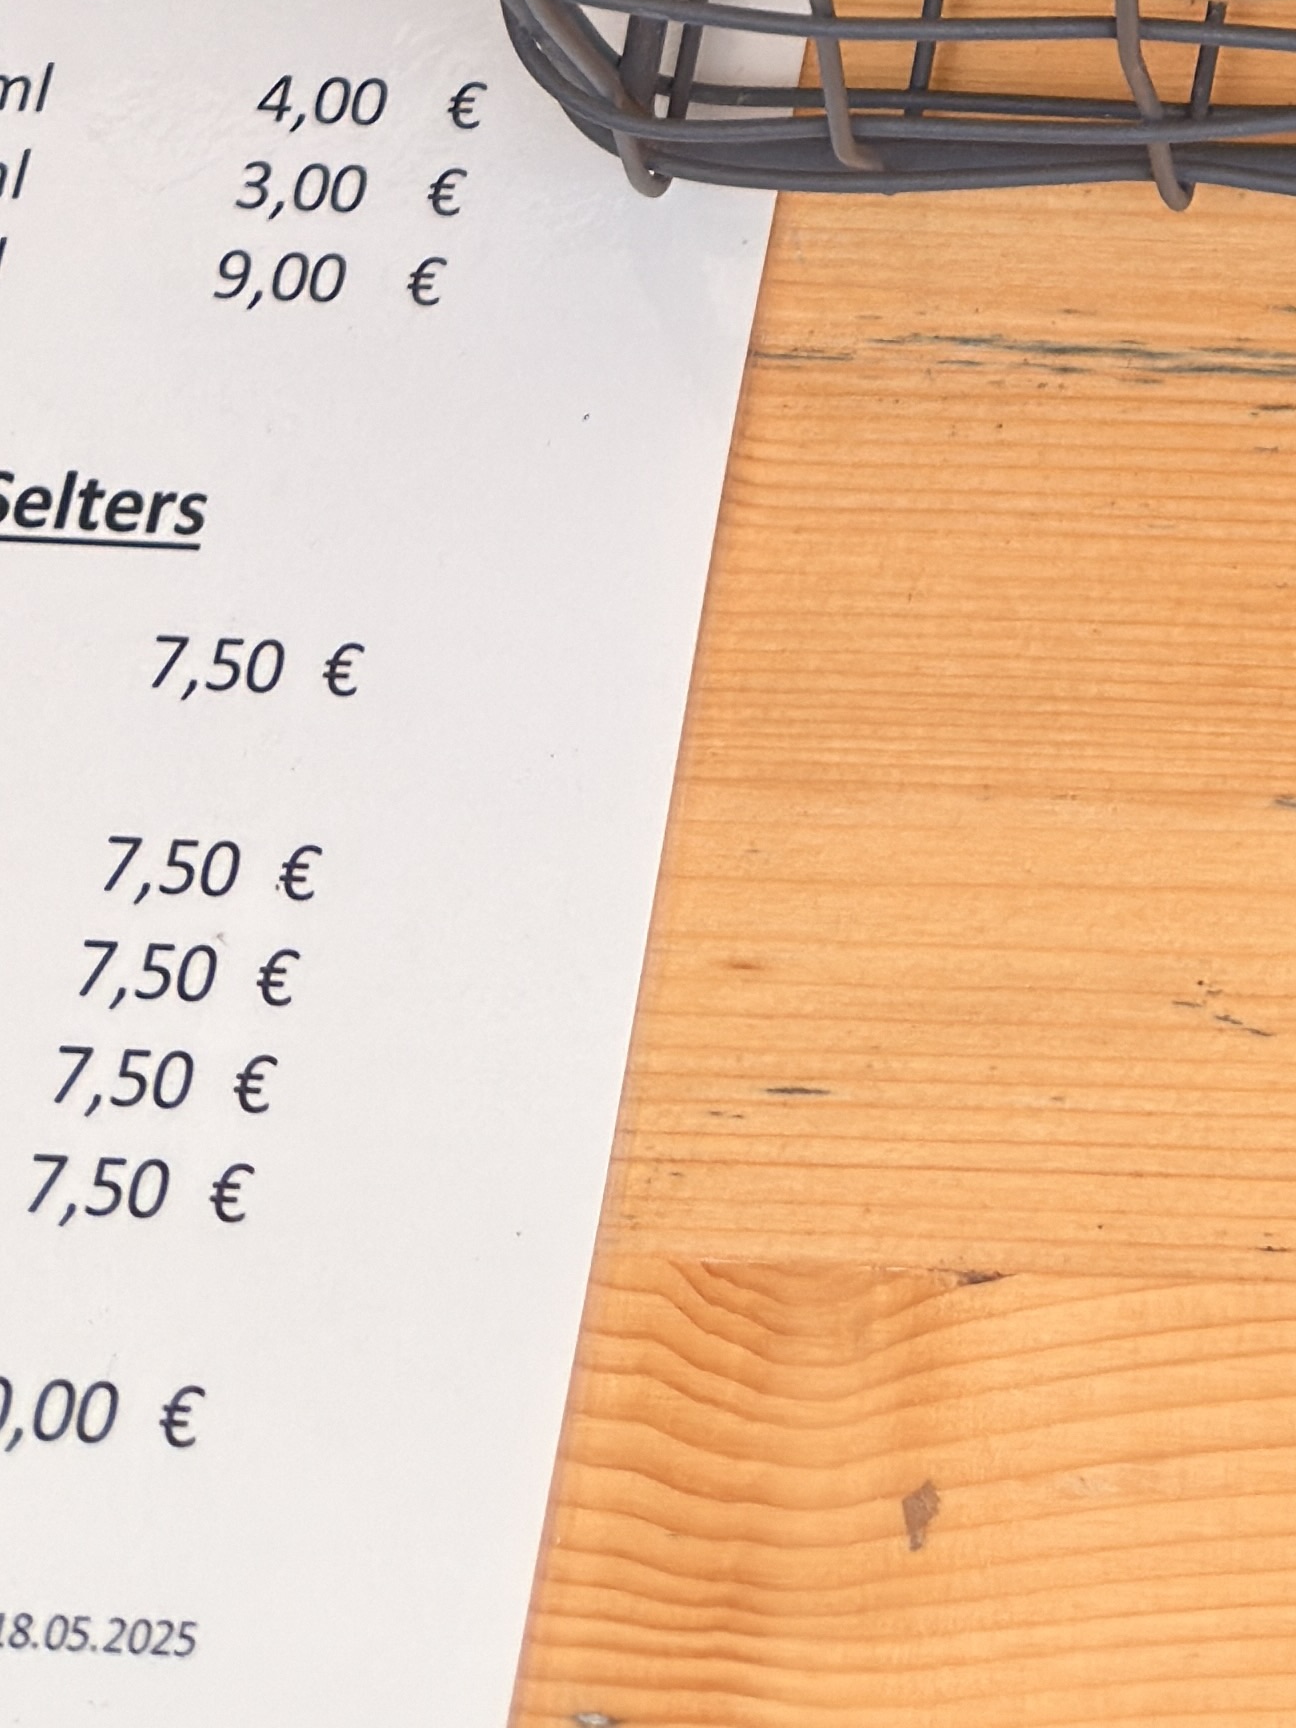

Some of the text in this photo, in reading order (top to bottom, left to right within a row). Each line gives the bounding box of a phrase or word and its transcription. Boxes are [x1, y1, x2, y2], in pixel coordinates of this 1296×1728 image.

[256, 74, 388, 132] 4,00
[447, 81, 488, 130] €
[235, 161, 368, 220] 3,00
[427, 168, 468, 217] €
[213, 250, 447, 310] 9,00 €
[151, 634, 365, 701] 7,50 €
[103, 836, 323, 905] 7,50 €
[79, 939, 300, 1010] 7,50 €
[53, 1045, 278, 1117] 7,50 €
[27, 1153, 256, 1227] 7,50 €
[159, 1385, 206, 1448] €
